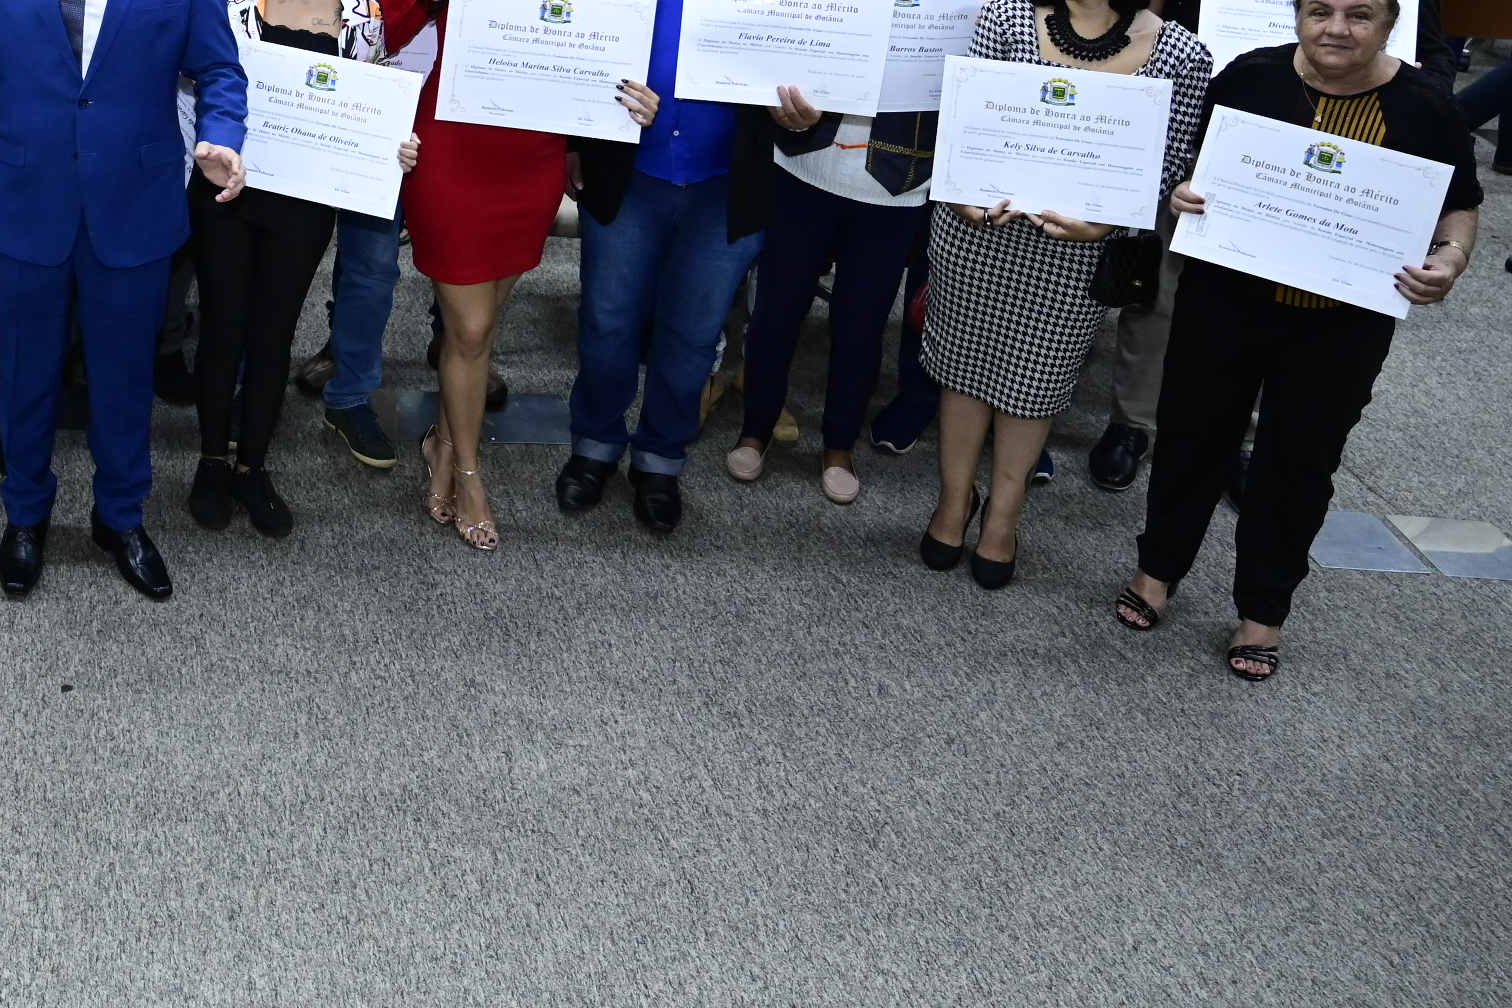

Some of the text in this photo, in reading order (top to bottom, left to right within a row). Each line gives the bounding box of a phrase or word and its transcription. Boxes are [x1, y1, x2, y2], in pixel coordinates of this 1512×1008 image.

[488, 19, 527, 34] Diploma
[530, 25, 539, 33] de
[765, 35, 796, 45] Pereira
[809, 39, 831, 48] Lima
[889, 45, 916, 53] Barros
[521, 61, 549, 72] Marina
[552, 64, 571, 74] Silva
[573, 67, 610, 78] Carvalho
[256, 81, 292, 97] Diploma
[295, 90, 305, 98] de
[339, 100, 348, 108] ao
[984, 101, 1027, 115] Diploma
[1030, 106, 1040, 115] de
[1045, 107, 1077, 120] Honra
[1079, 113, 1091, 122] ao
[262, 120, 289, 132] Beatriz
[318, 133, 328, 141] de
[329, 134, 359, 148] Oliveira
[1026, 143, 1045, 153] Silva
[1048, 146, 1058, 154] de
[1061, 147, 1101, 160] Carvalho
[1240, 154, 1400, 206] Diploma de Honra ao Mérito
[1289, 182, 1332, 199] Municipal
[1334, 194, 1344, 202] de
[1255, 200, 1359, 236] Arlete Gomes da Mota
